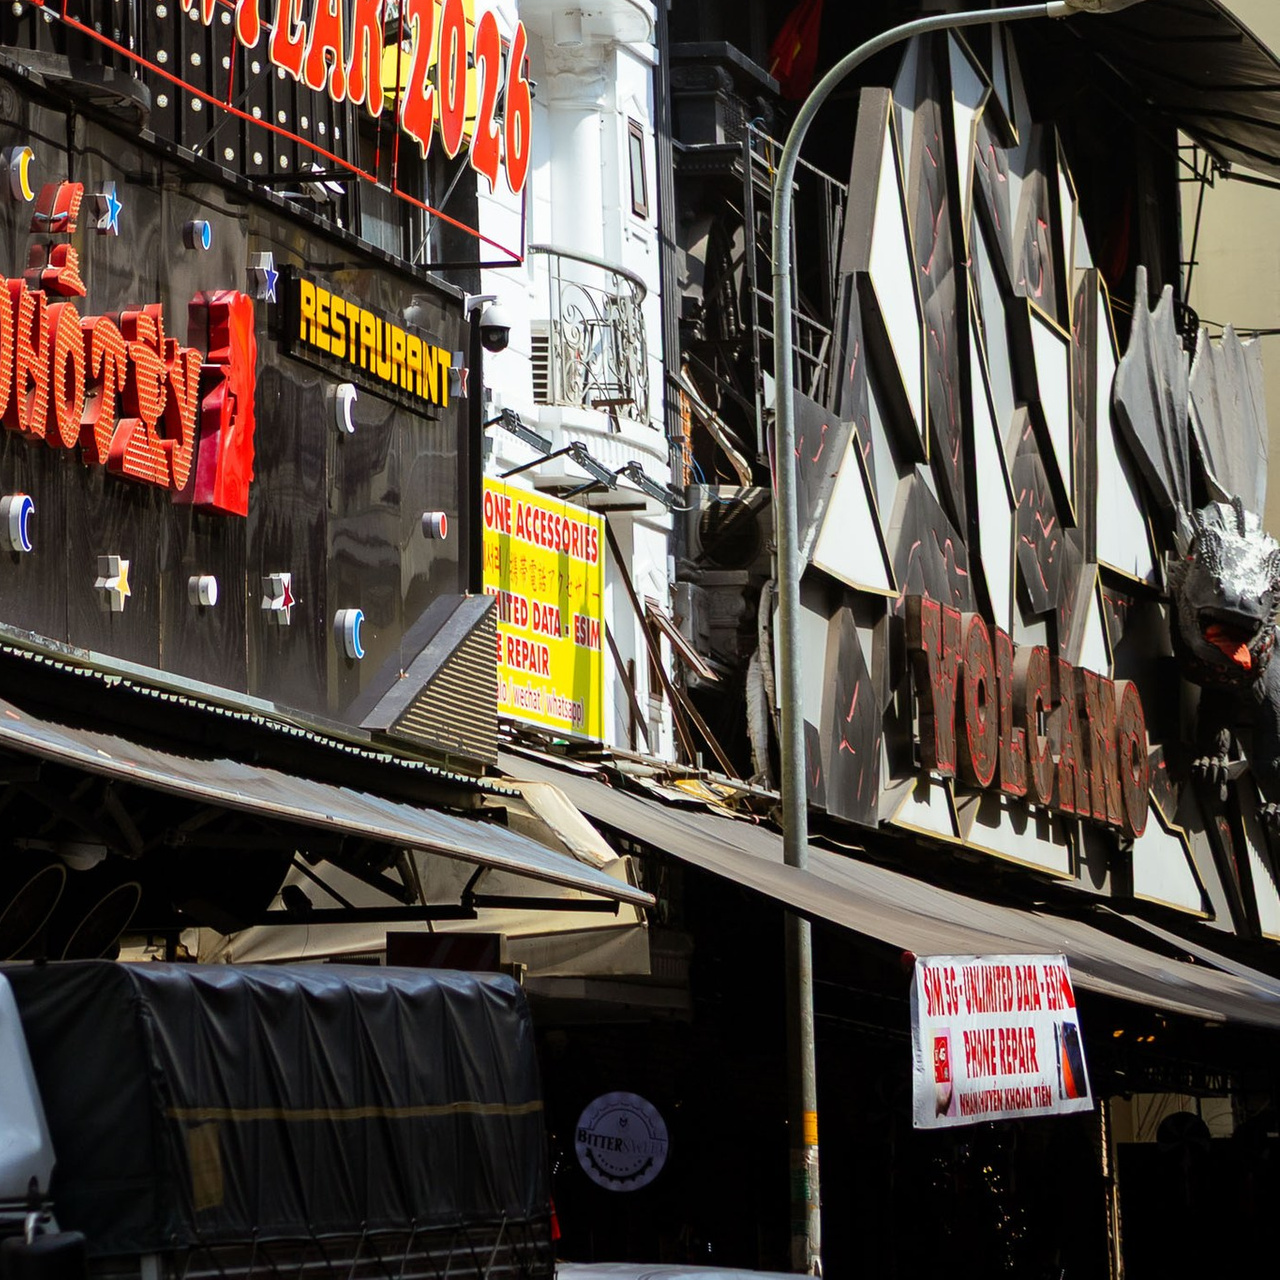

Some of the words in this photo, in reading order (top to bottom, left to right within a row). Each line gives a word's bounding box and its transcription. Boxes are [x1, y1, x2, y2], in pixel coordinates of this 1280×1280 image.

[300, 277, 452, 409] RESTAURANT
[516, 500, 598, 564] ACCESSORIES
[532, 601, 562, 638] DATA
[574, 614, 601, 651] ESIM
[507, 636, 549, 676] REPAIR
[918, 595, 1150, 838] VOLCANO
[923, 966, 945, 1017] SIM
[962, 965, 1014, 1015] UNLIMITED
[1015, 965, 1042, 1012] DATA
[963, 1028, 996, 1079] PHONE
[998, 1026, 1039, 1075] REPAIR
